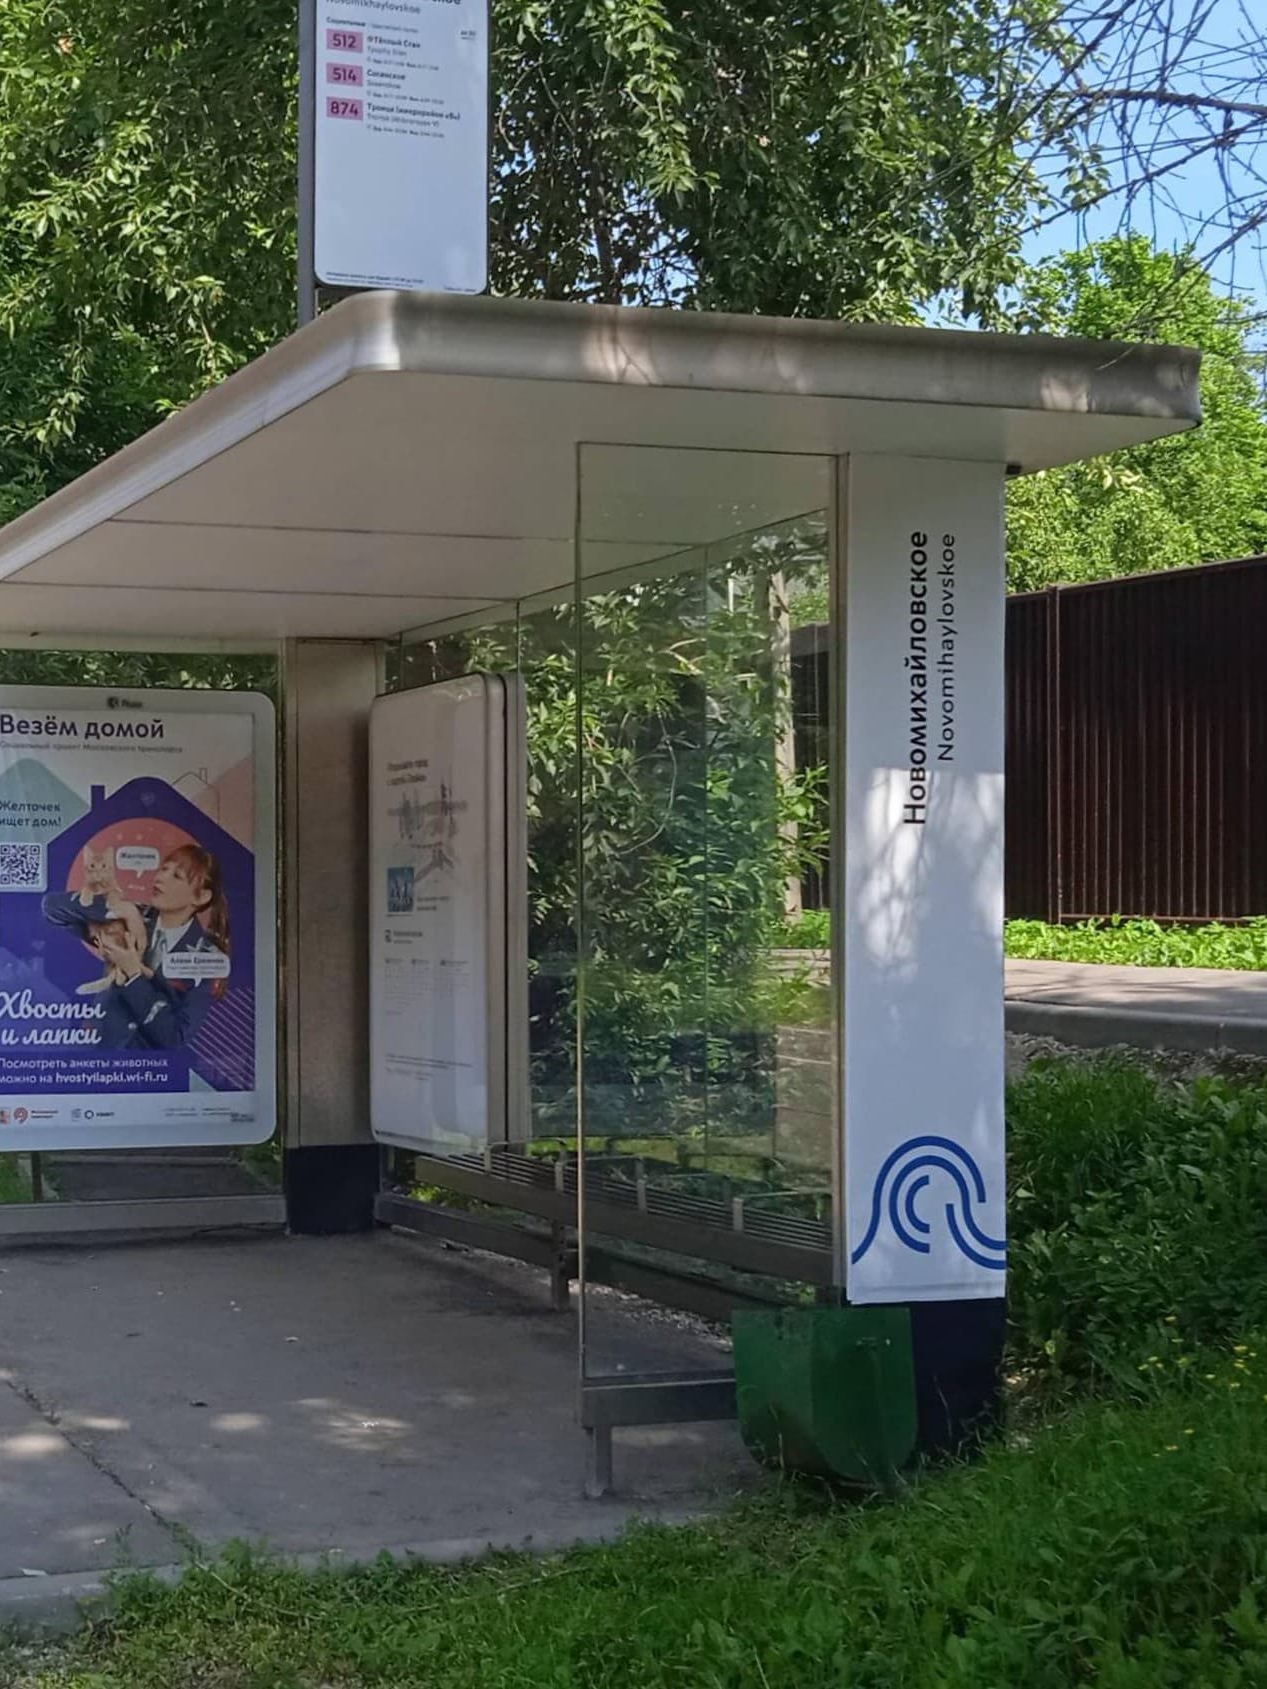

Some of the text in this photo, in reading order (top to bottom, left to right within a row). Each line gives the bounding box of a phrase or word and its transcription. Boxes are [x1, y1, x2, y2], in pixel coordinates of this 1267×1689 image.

[333, 33, 357, 49] 512
[333, 67, 357, 83] 514
[330, 101, 359, 116] 874
[937, 533, 958, 761] Novomihaylovskoe
[903, 531, 929, 825] Новомихайловское
[0, 713, 165, 740] Везём домой
[31, 816, 62, 828] дом!
[1, 1028, 103, 1046] и лапки
[69, 1059, 110, 1068] анкеты
[112, 1058, 169, 1068] животных
[39, 1075, 53, 1084] на
